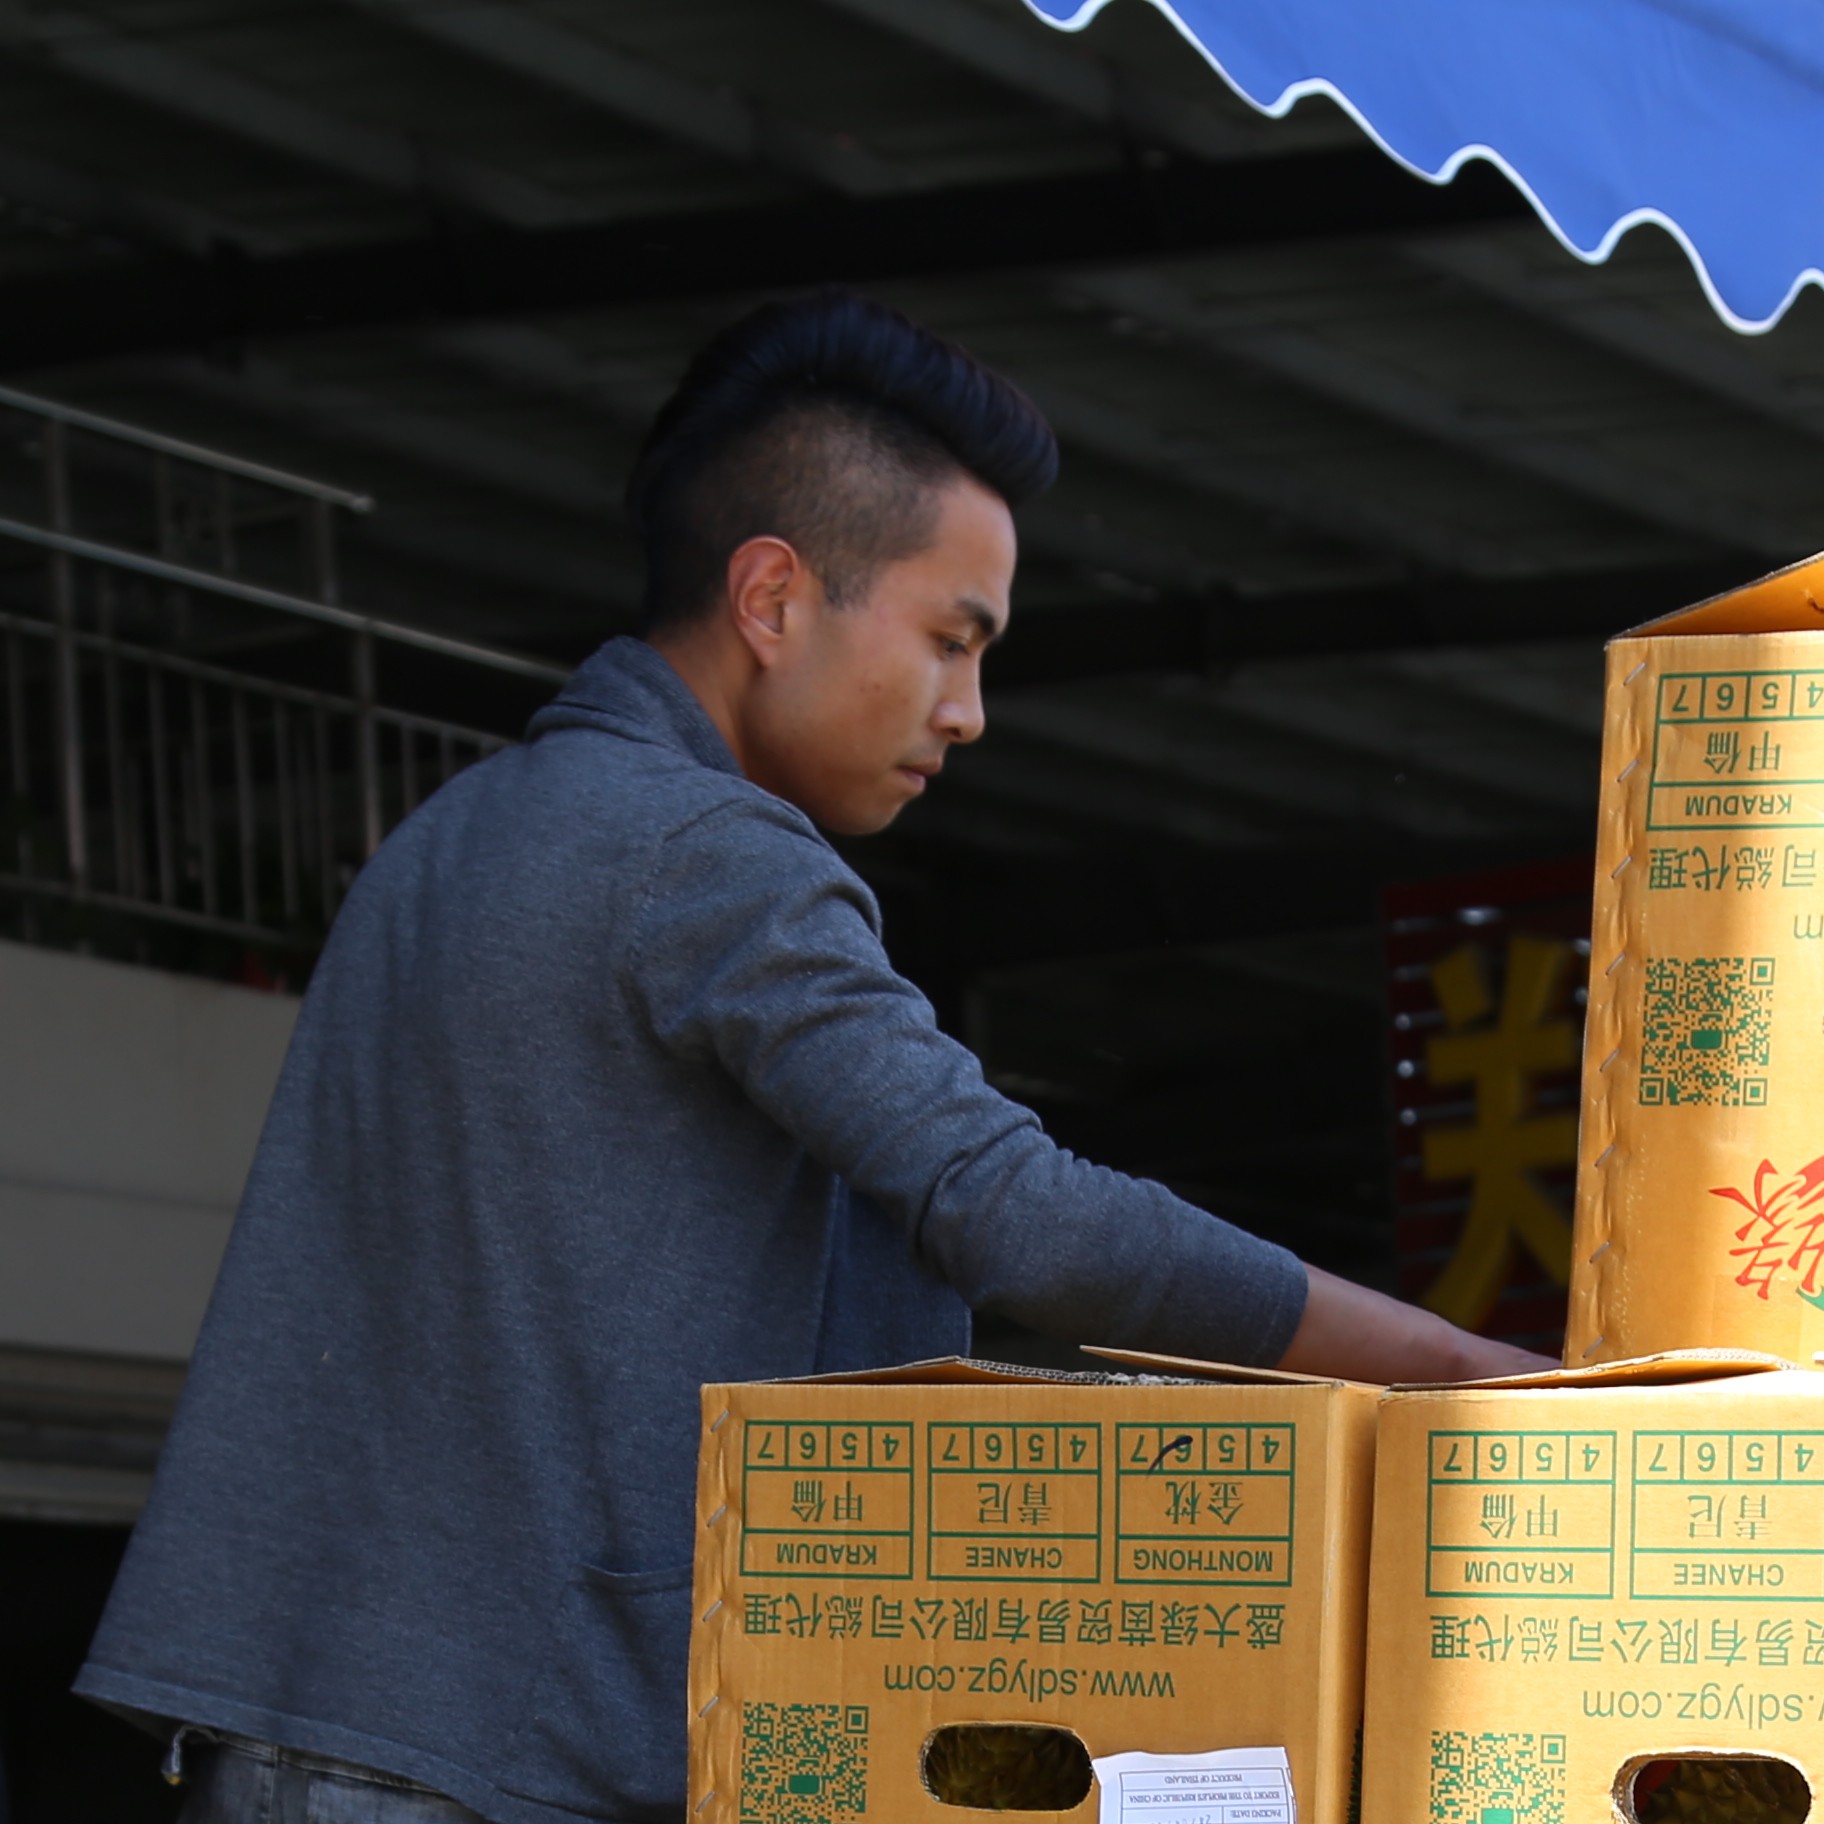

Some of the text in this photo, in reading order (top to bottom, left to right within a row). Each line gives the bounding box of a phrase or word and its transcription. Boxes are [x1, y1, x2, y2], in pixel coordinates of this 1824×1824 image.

[1684, 792, 1794, 817] KRADUM
[976, 1480, 1054, 1526] 青尼
[1164, 1480, 1244, 1526] 金枕
[1684, 1492, 1774, 1541] 青尼
[776, 1541, 878, 1565] KRADUM
[965, 1545, 1063, 1569] CHANEE
[1132, 1547, 1274, 1573] MONTHONG
[1463, 1559, 1575, 1584] KRADUM
[1673, 1561, 1785, 1587] CHANEE
[883, 1656, 1175, 1704] www.sdlygz.com
